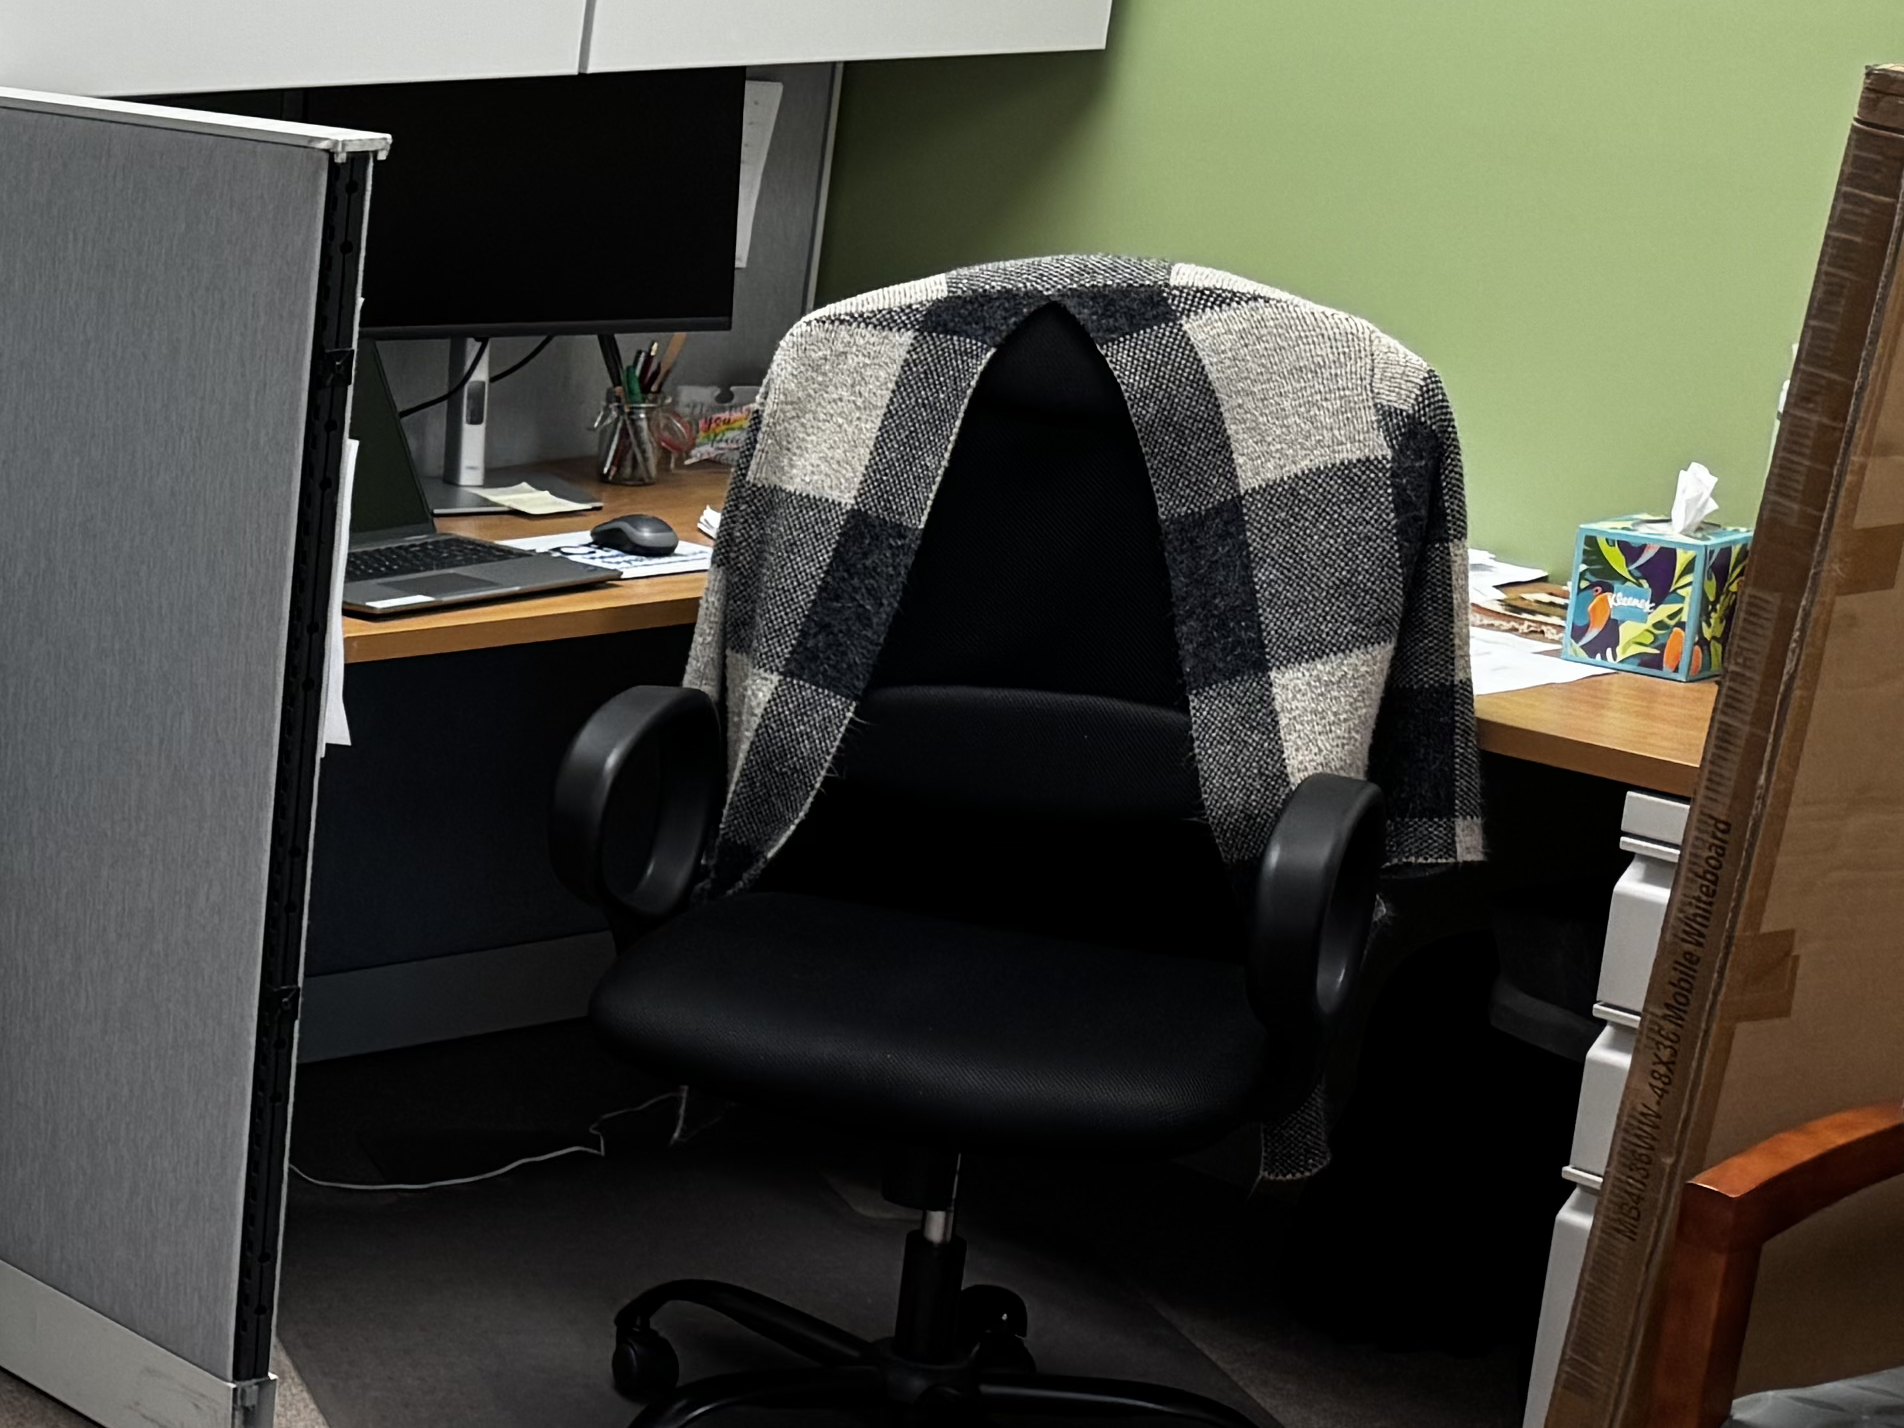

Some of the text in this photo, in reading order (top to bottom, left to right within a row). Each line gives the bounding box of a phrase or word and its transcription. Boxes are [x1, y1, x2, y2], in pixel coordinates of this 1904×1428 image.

[1608, 591, 1656, 613] Kleenex
[1680, 814, 1732, 950] Whiteboard
[1663, 948, 1701, 1028] Mobile
